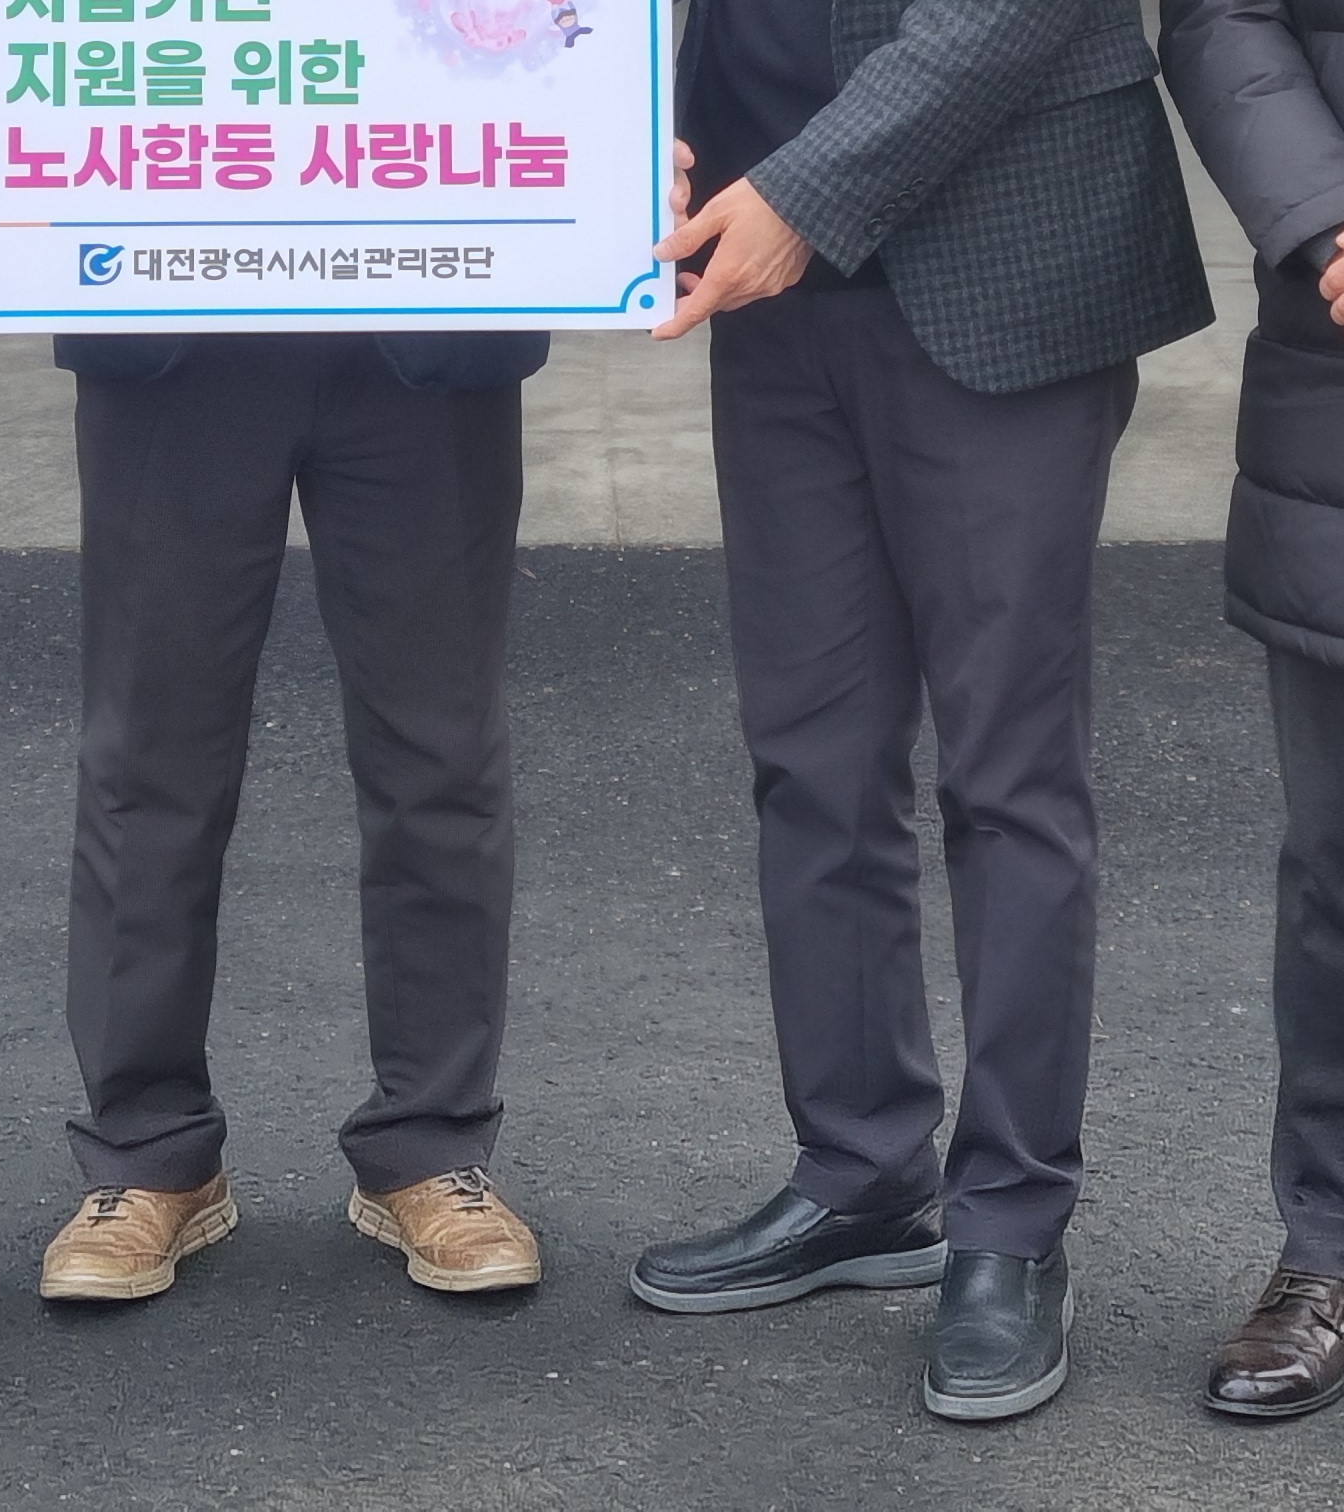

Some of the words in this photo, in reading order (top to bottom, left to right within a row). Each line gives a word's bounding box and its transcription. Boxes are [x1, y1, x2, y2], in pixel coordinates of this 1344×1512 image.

[5, 39, 207, 107] 지원을
[231, 38, 366, 106] 위한
[4, 123, 276, 191] 노사합동
[299, 121, 570, 190] 사랑나눔
[133, 246, 495, 282] 대전광역시시설관리공단
